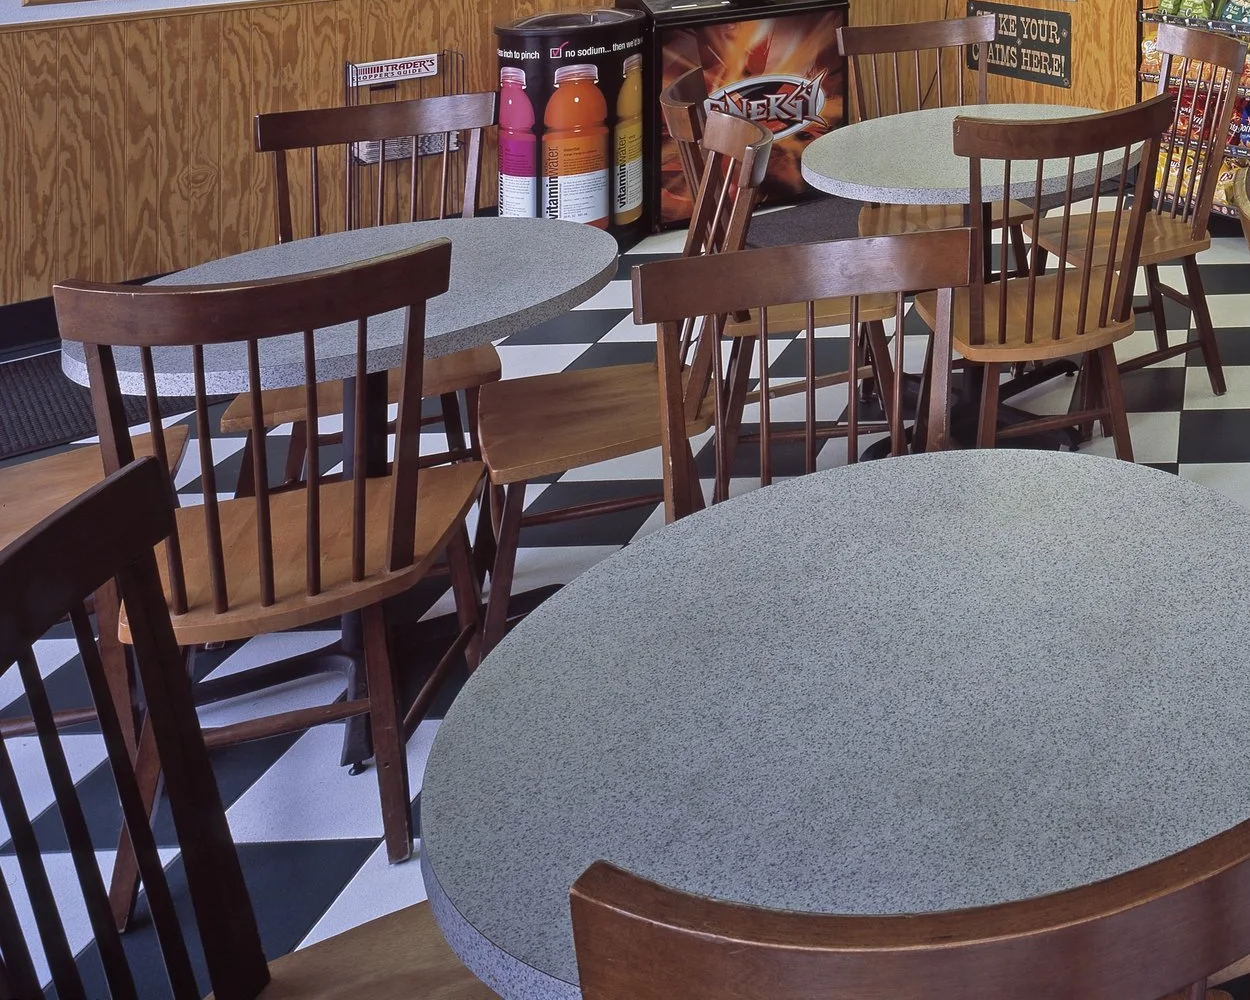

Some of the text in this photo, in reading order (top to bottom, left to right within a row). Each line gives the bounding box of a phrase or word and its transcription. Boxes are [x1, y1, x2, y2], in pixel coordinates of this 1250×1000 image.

[1020, 16, 1060, 44] YOUR
[514, 50, 521, 58] to
[521, 50, 540, 61] pinch
[565, 50, 576, 58] no
[612, 42, 626, 52] then
[384, 59, 435, 73] TRADER'S
[972, 43, 1065, 78] CAIMS HERE!
[397, 68, 422, 76] GUIDE
[704, 68, 828, 127] ENERGY
